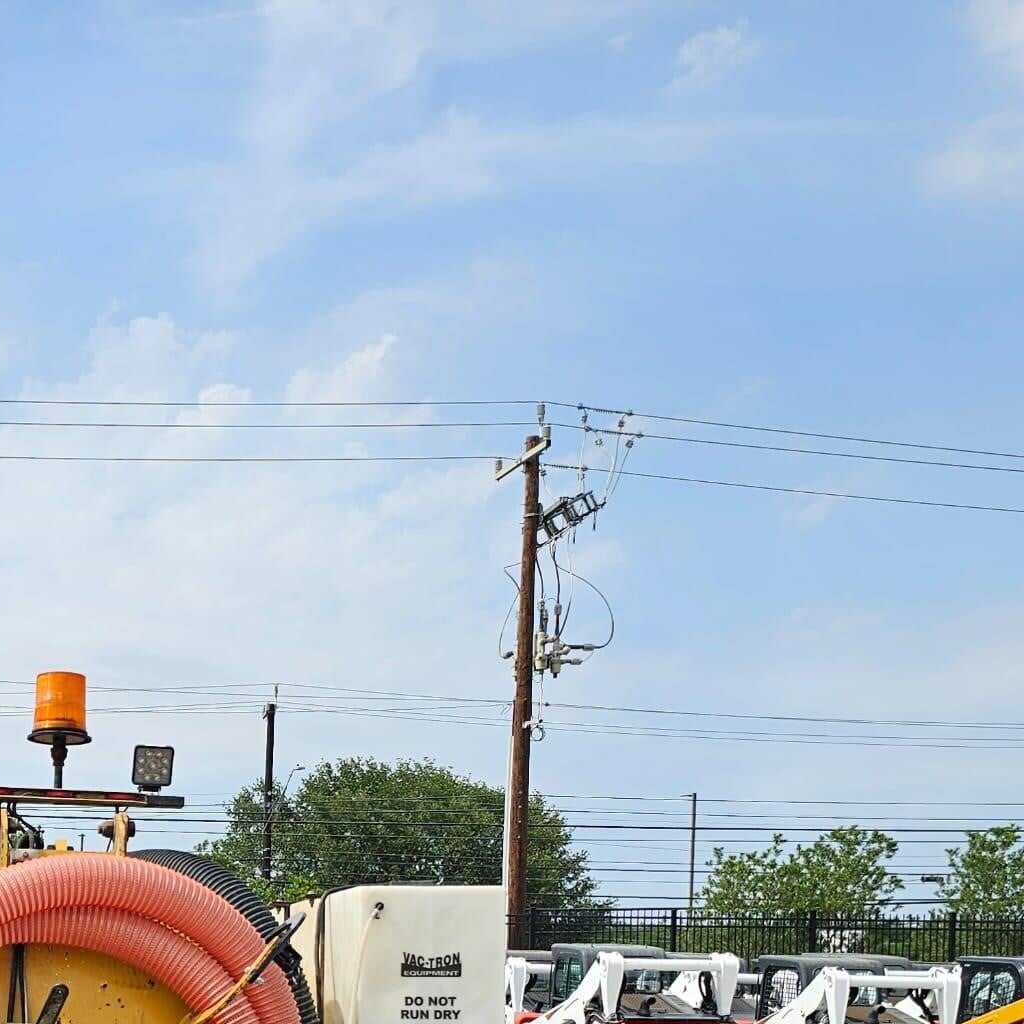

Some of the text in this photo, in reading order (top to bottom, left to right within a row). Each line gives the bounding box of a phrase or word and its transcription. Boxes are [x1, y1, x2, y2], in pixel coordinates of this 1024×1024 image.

[403, 952, 460, 969] VAC-TRON
[405, 996, 456, 1006] DO NOT
[401, 1010, 461, 1019] RUN DRY
